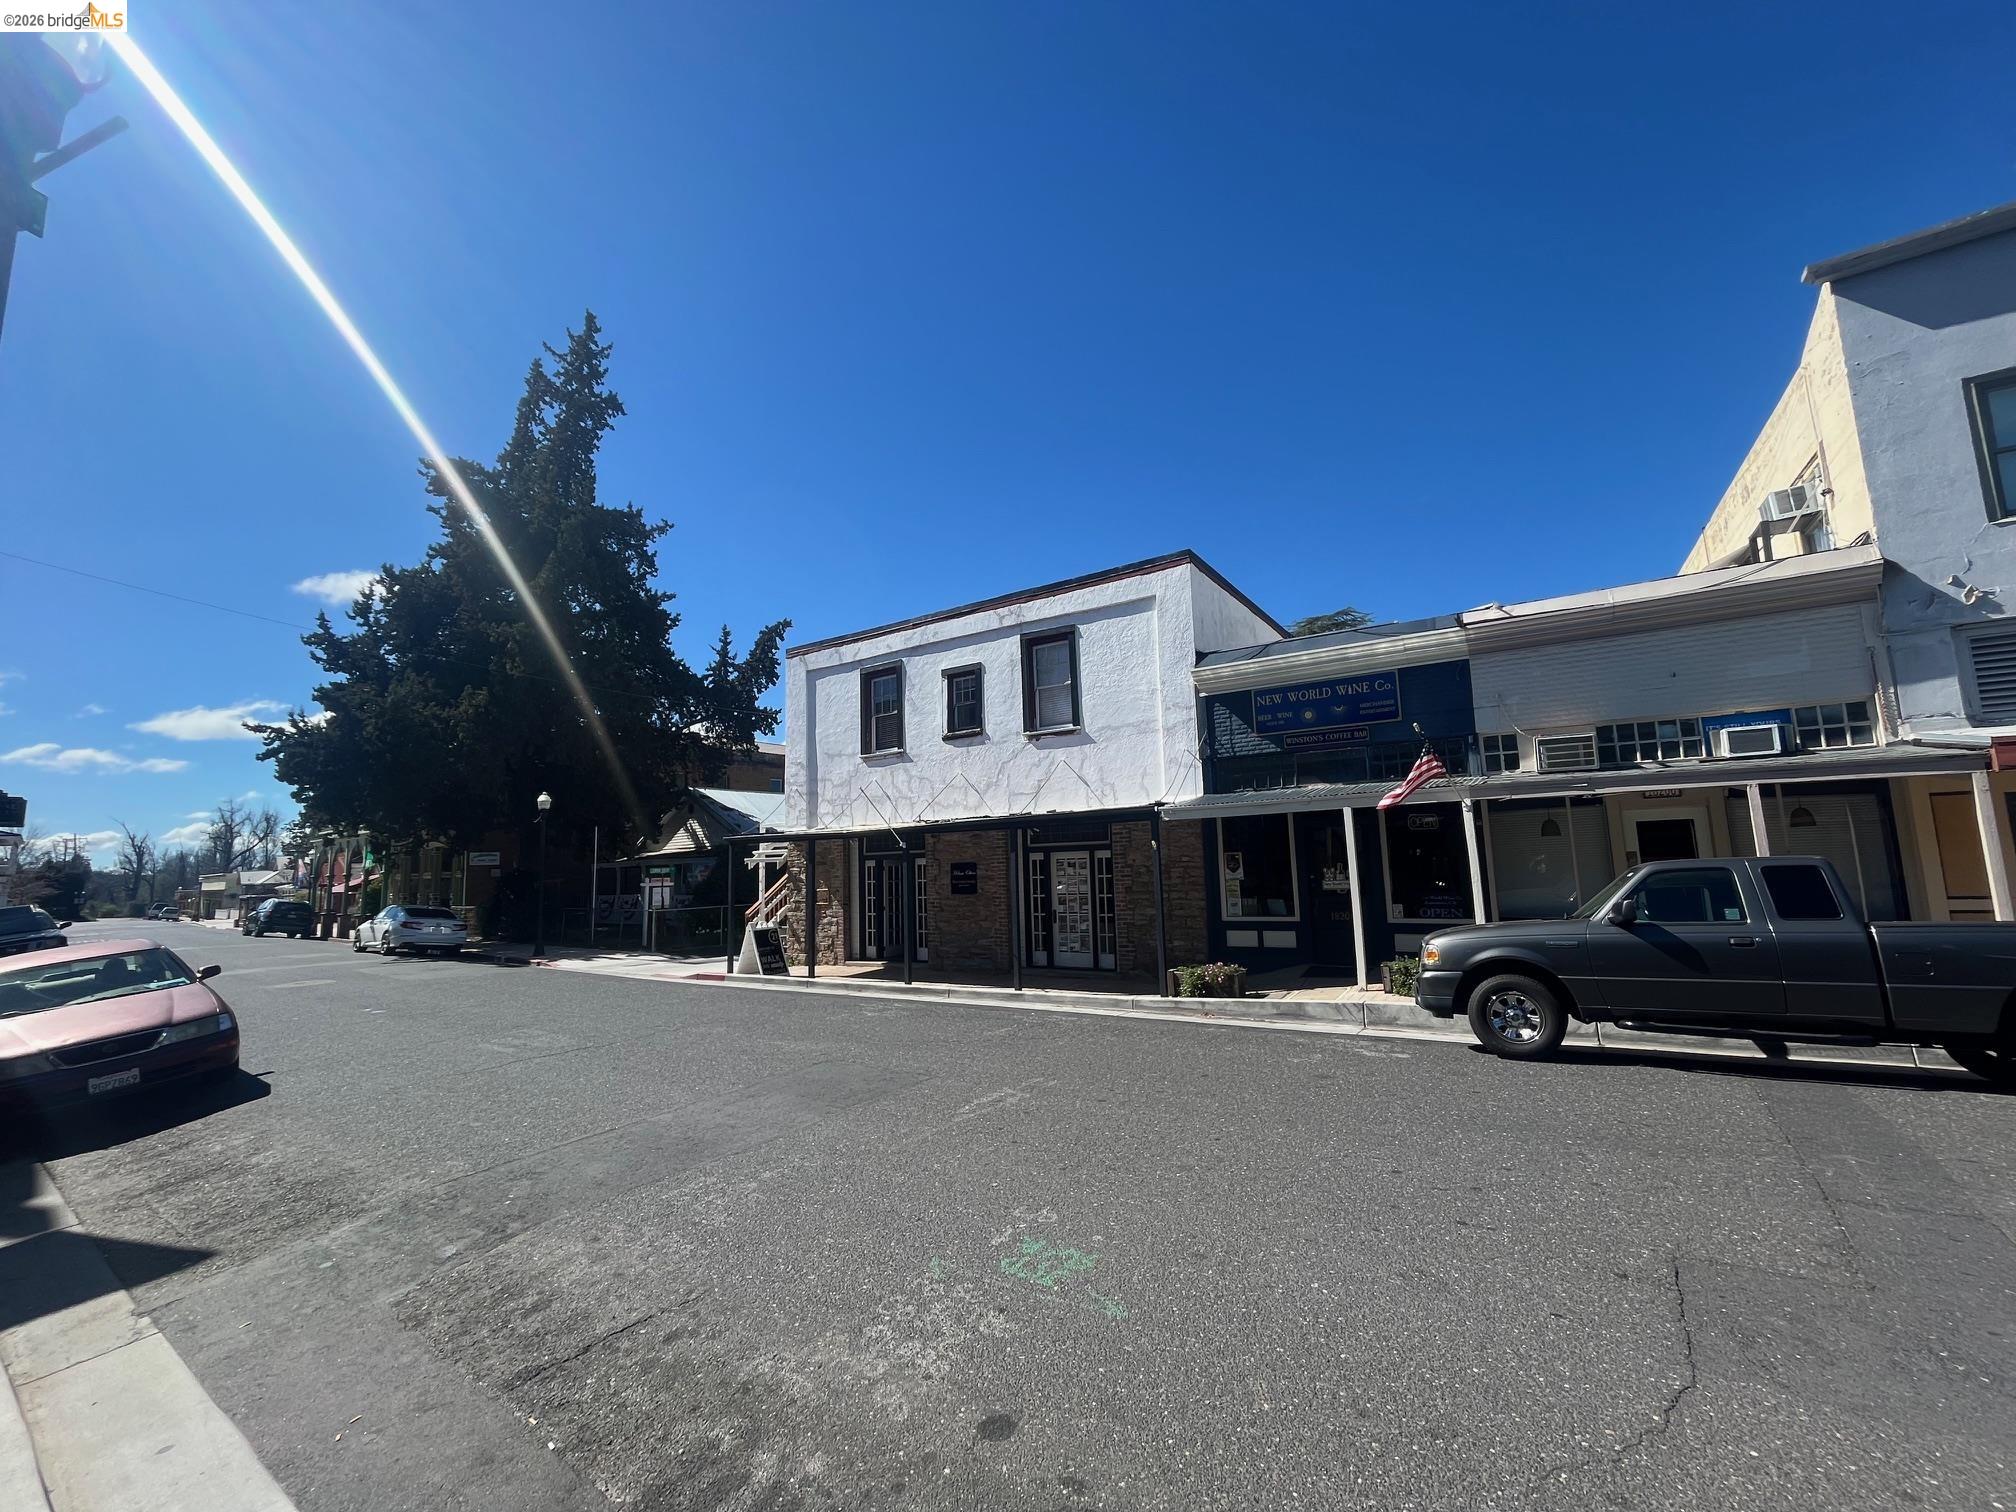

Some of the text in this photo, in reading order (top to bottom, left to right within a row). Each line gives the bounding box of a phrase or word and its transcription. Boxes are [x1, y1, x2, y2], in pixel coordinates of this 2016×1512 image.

[1256, 680, 1394, 707] NEW WORLD WINE Co.
[1325, 731, 1352, 741] COFFEE
[1353, 729, 1367, 738] BAR
[1419, 907, 1464, 918] OPEN
